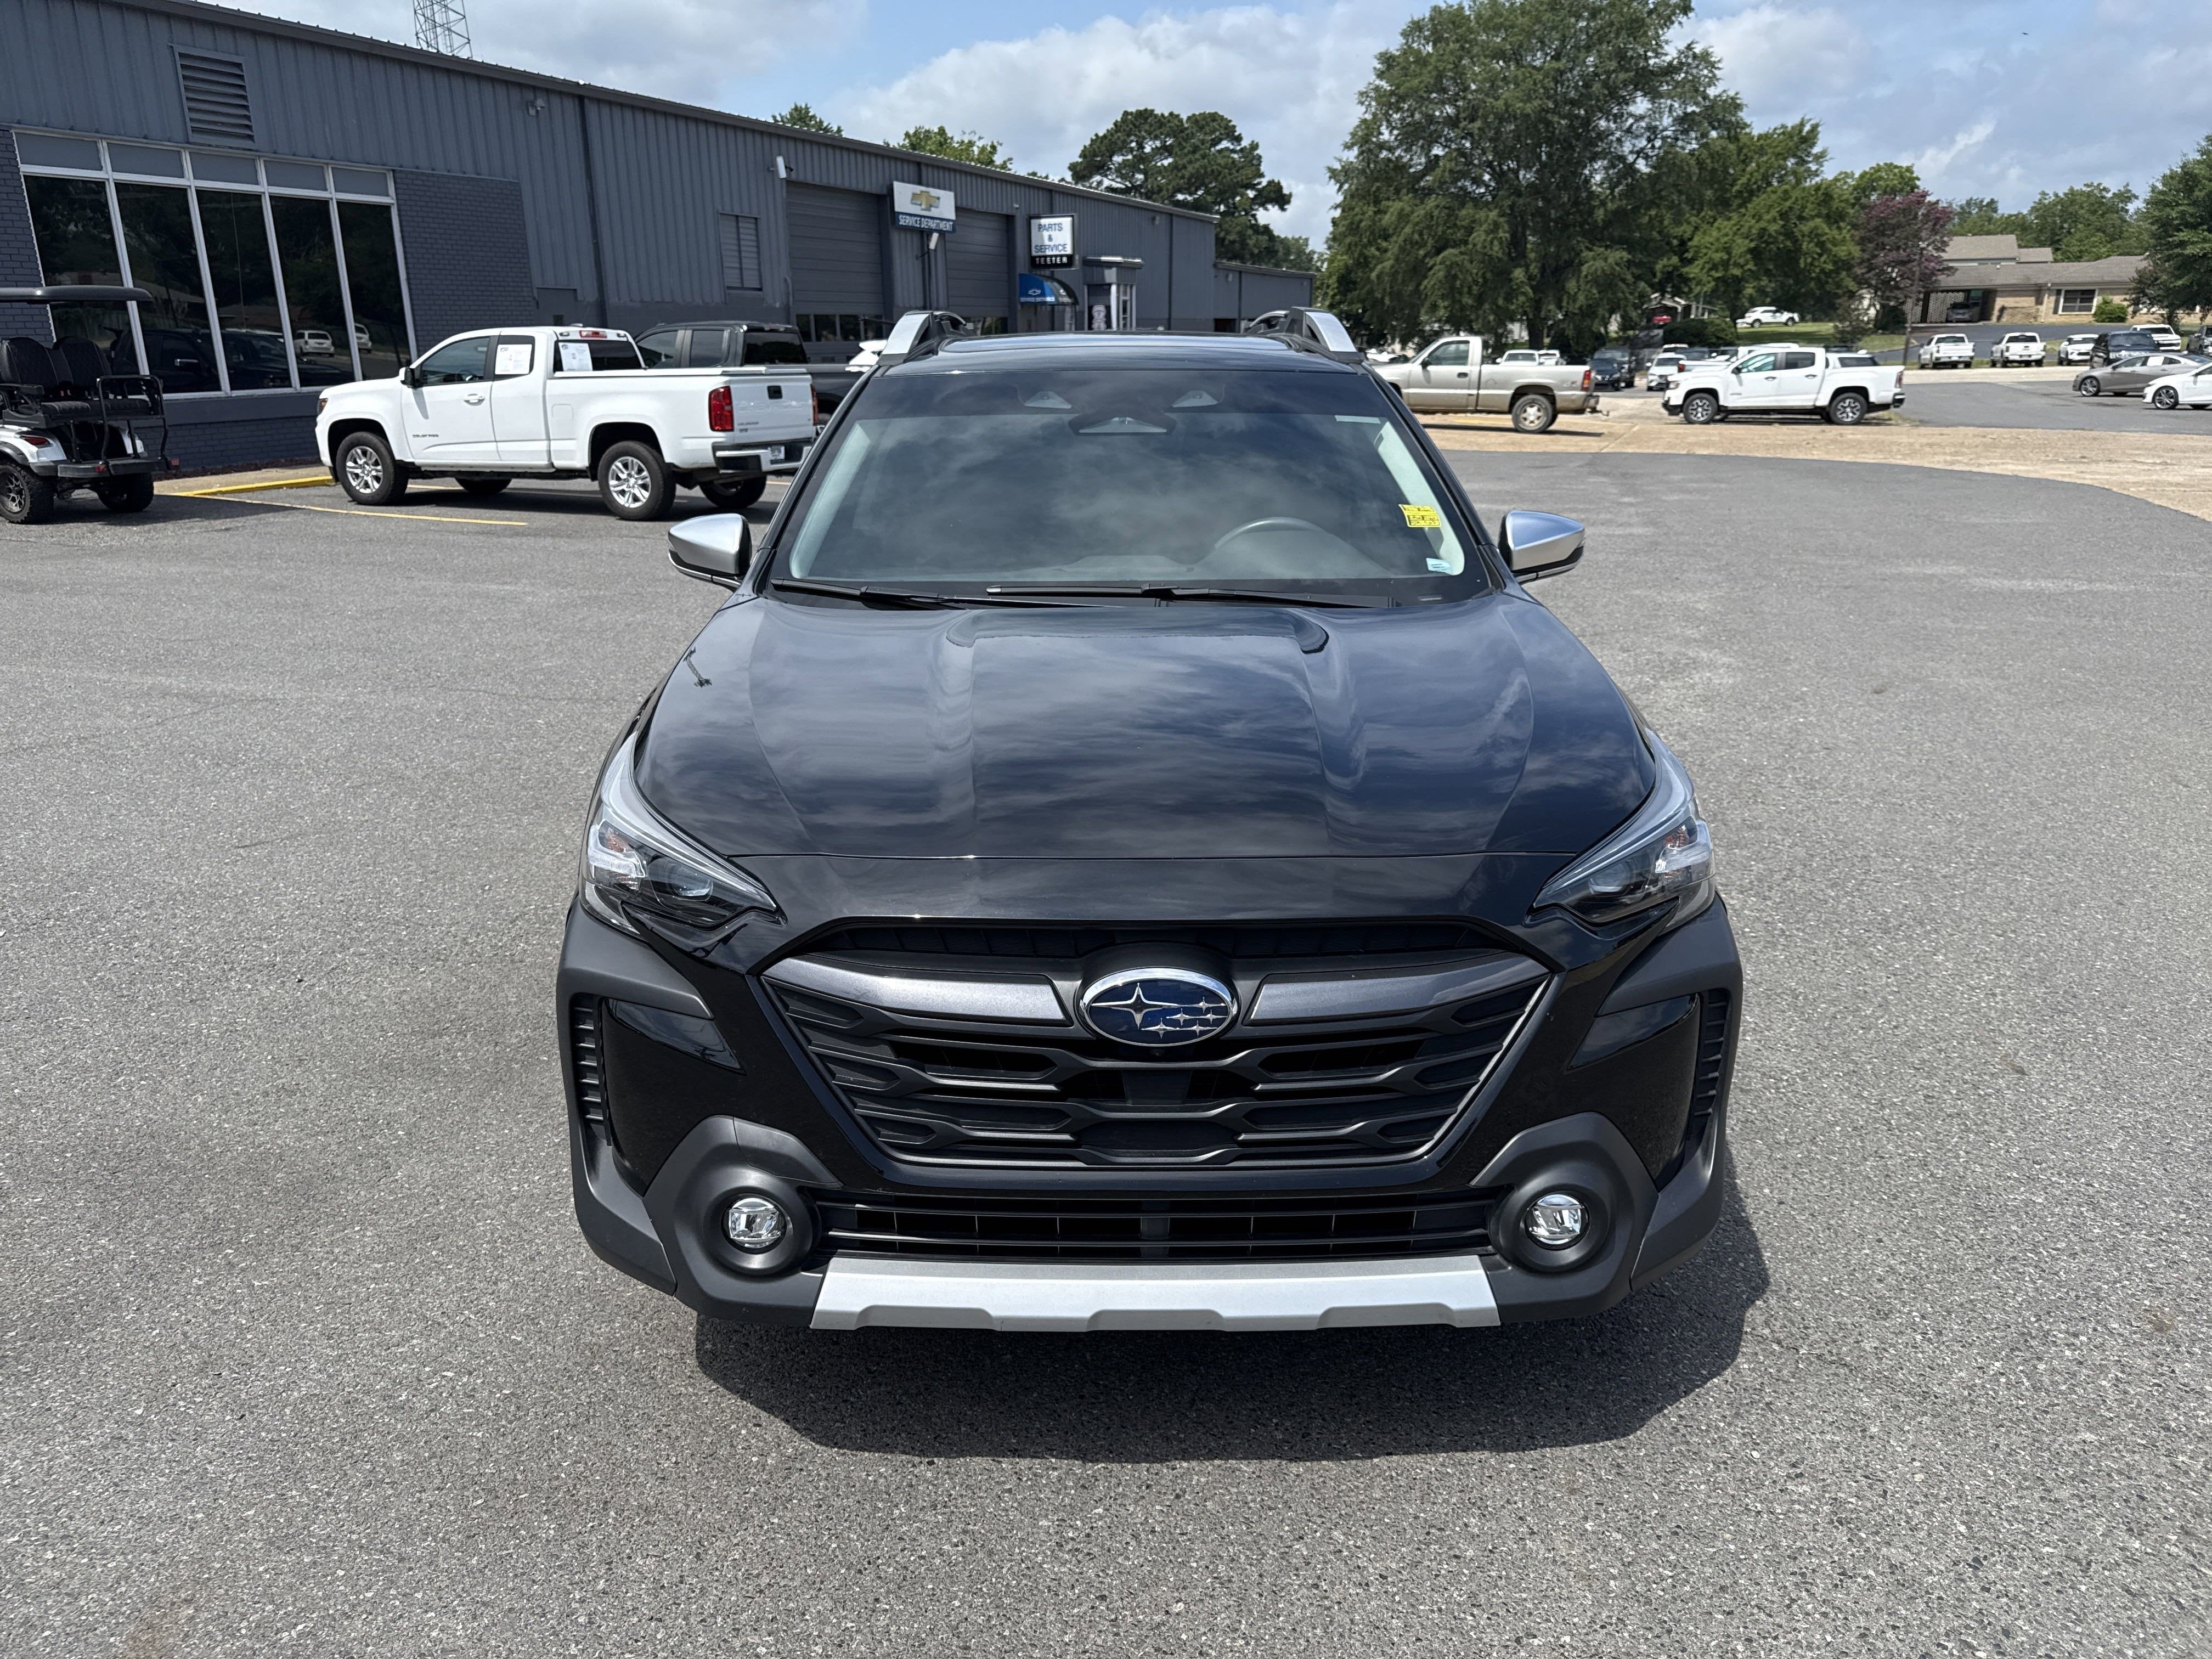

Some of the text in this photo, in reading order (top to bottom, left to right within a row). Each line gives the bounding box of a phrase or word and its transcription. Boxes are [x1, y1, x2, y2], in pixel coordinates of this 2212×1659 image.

[899, 215, 953, 231] SERVICE DEPARTMENT
[1037, 223, 1063, 232] PARTS
[1048, 234, 1053, 242] &
[1034, 244, 1068, 253] SERVICE
